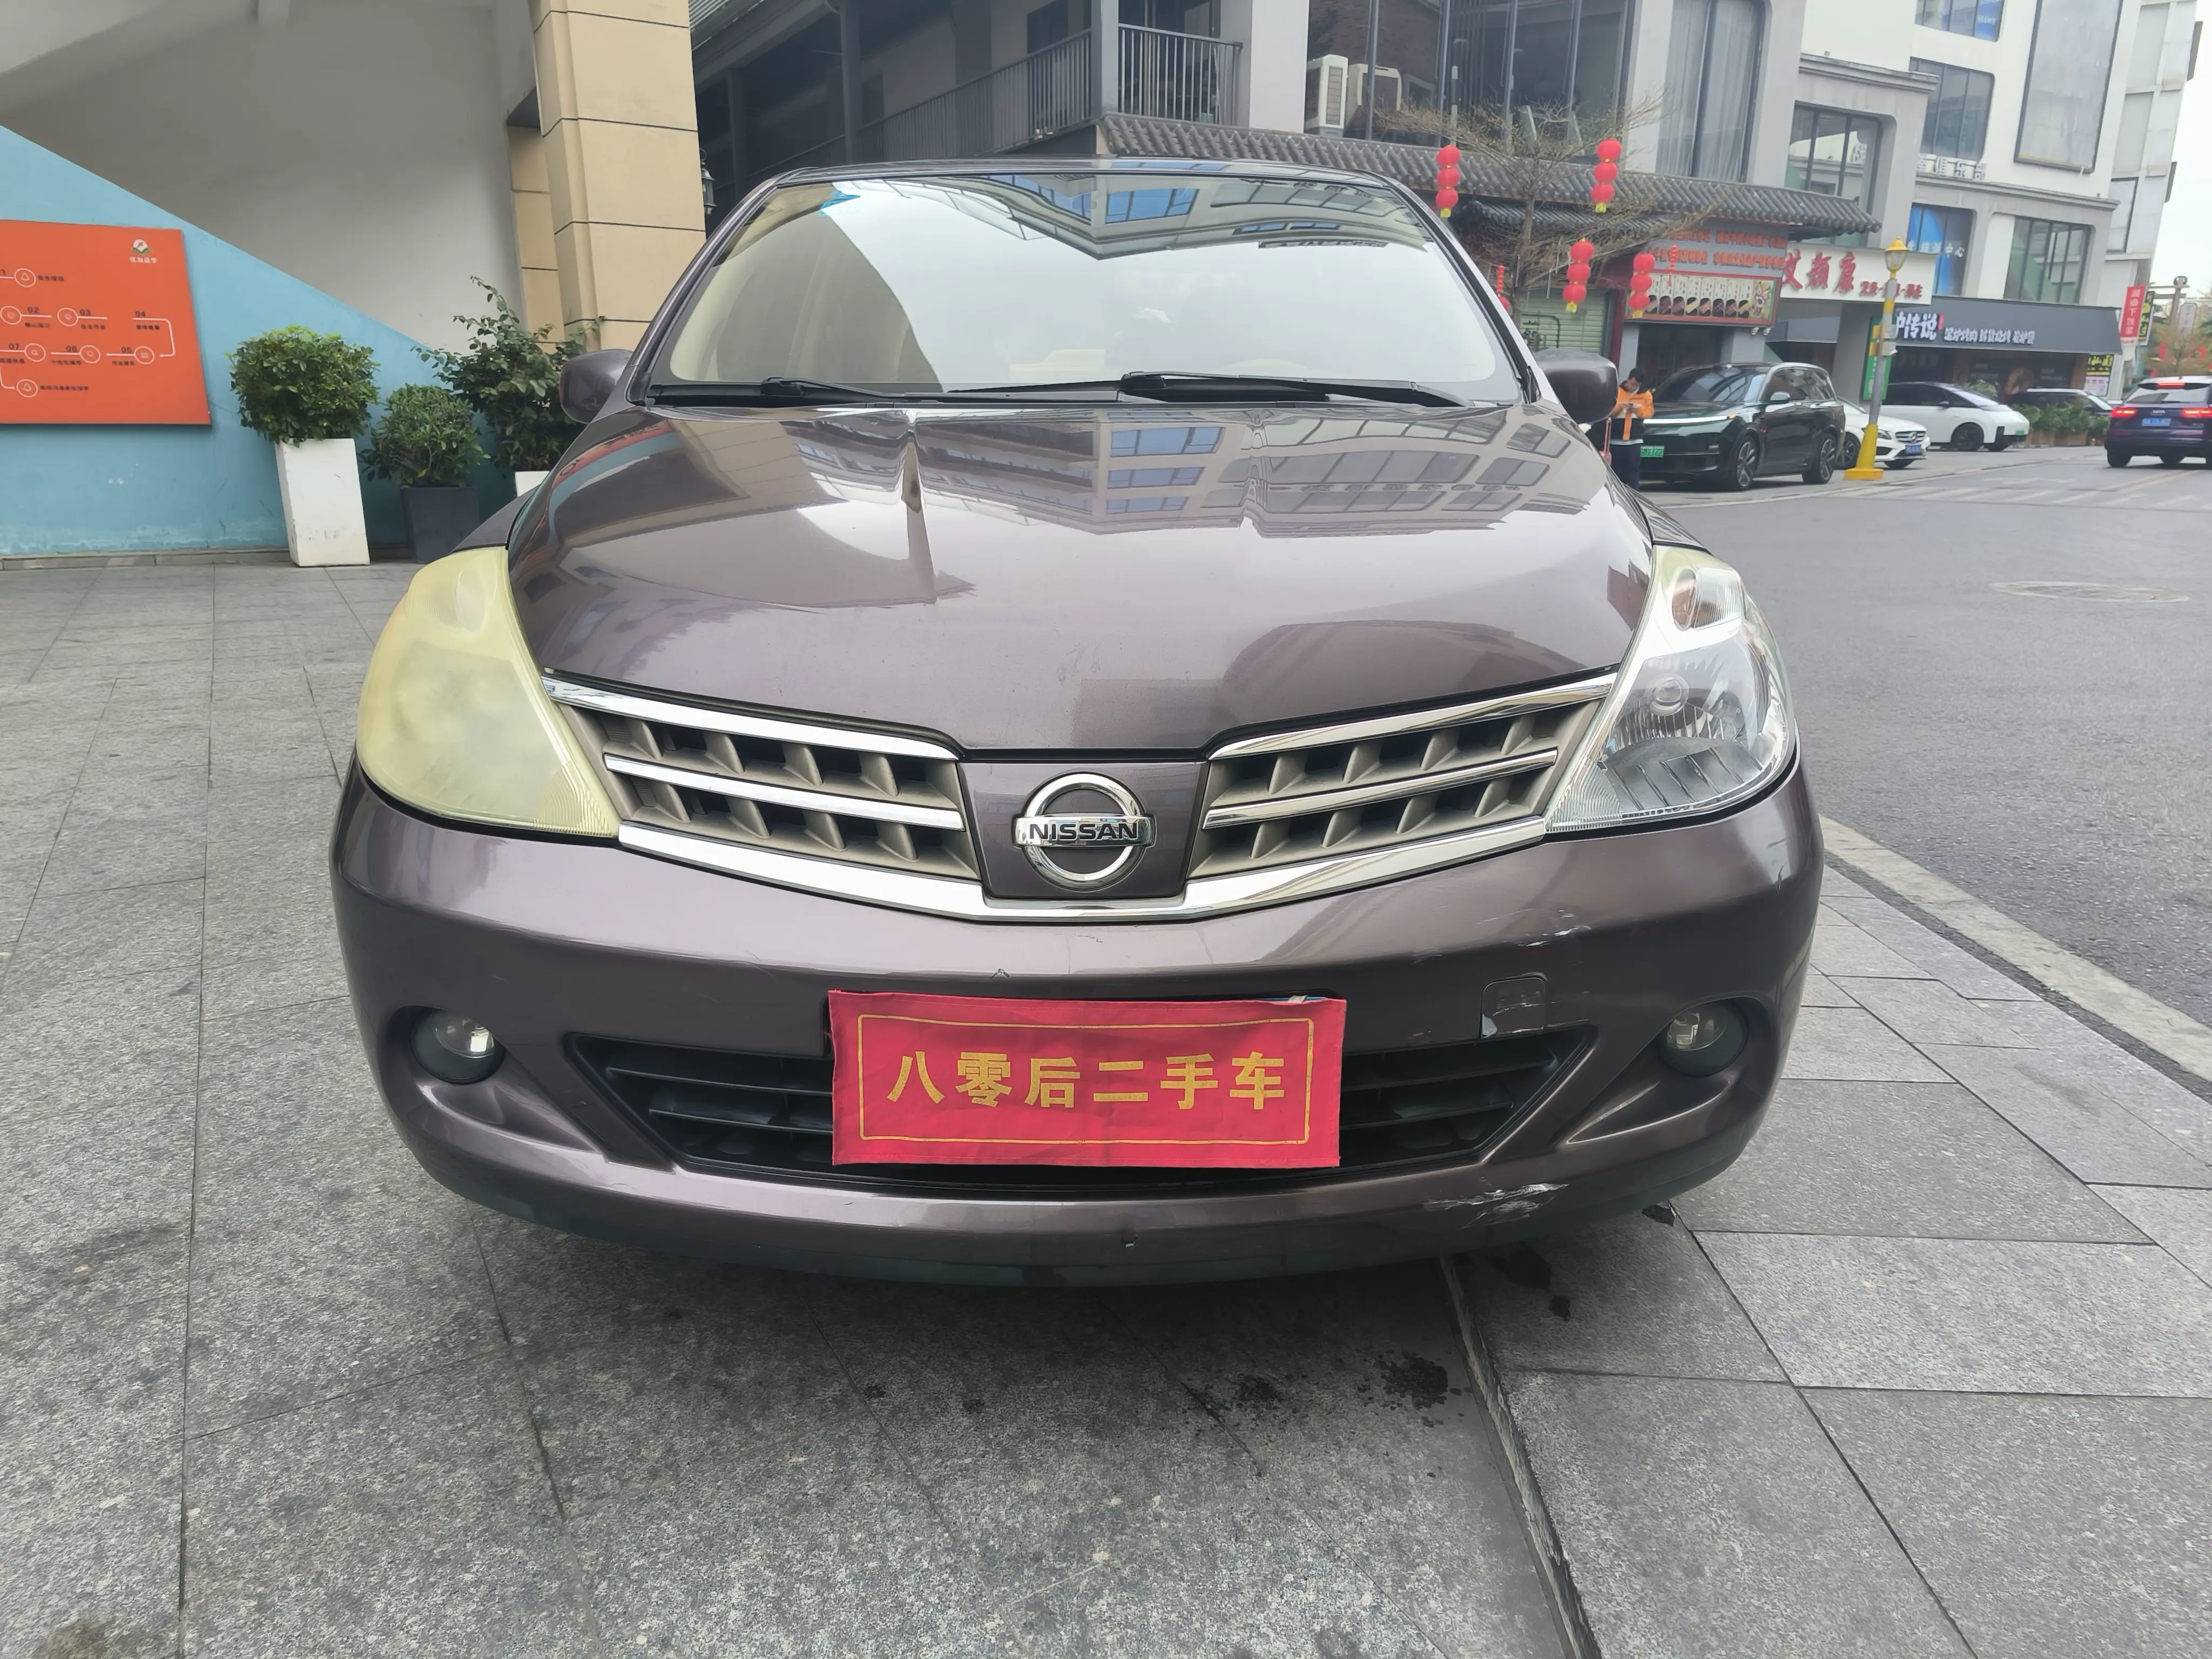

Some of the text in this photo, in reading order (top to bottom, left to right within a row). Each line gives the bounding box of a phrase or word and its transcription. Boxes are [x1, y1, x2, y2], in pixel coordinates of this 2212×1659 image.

[1029, 823, 1138, 840] NISSAN
[887, 1050, 1285, 1110] 八零后二手车
